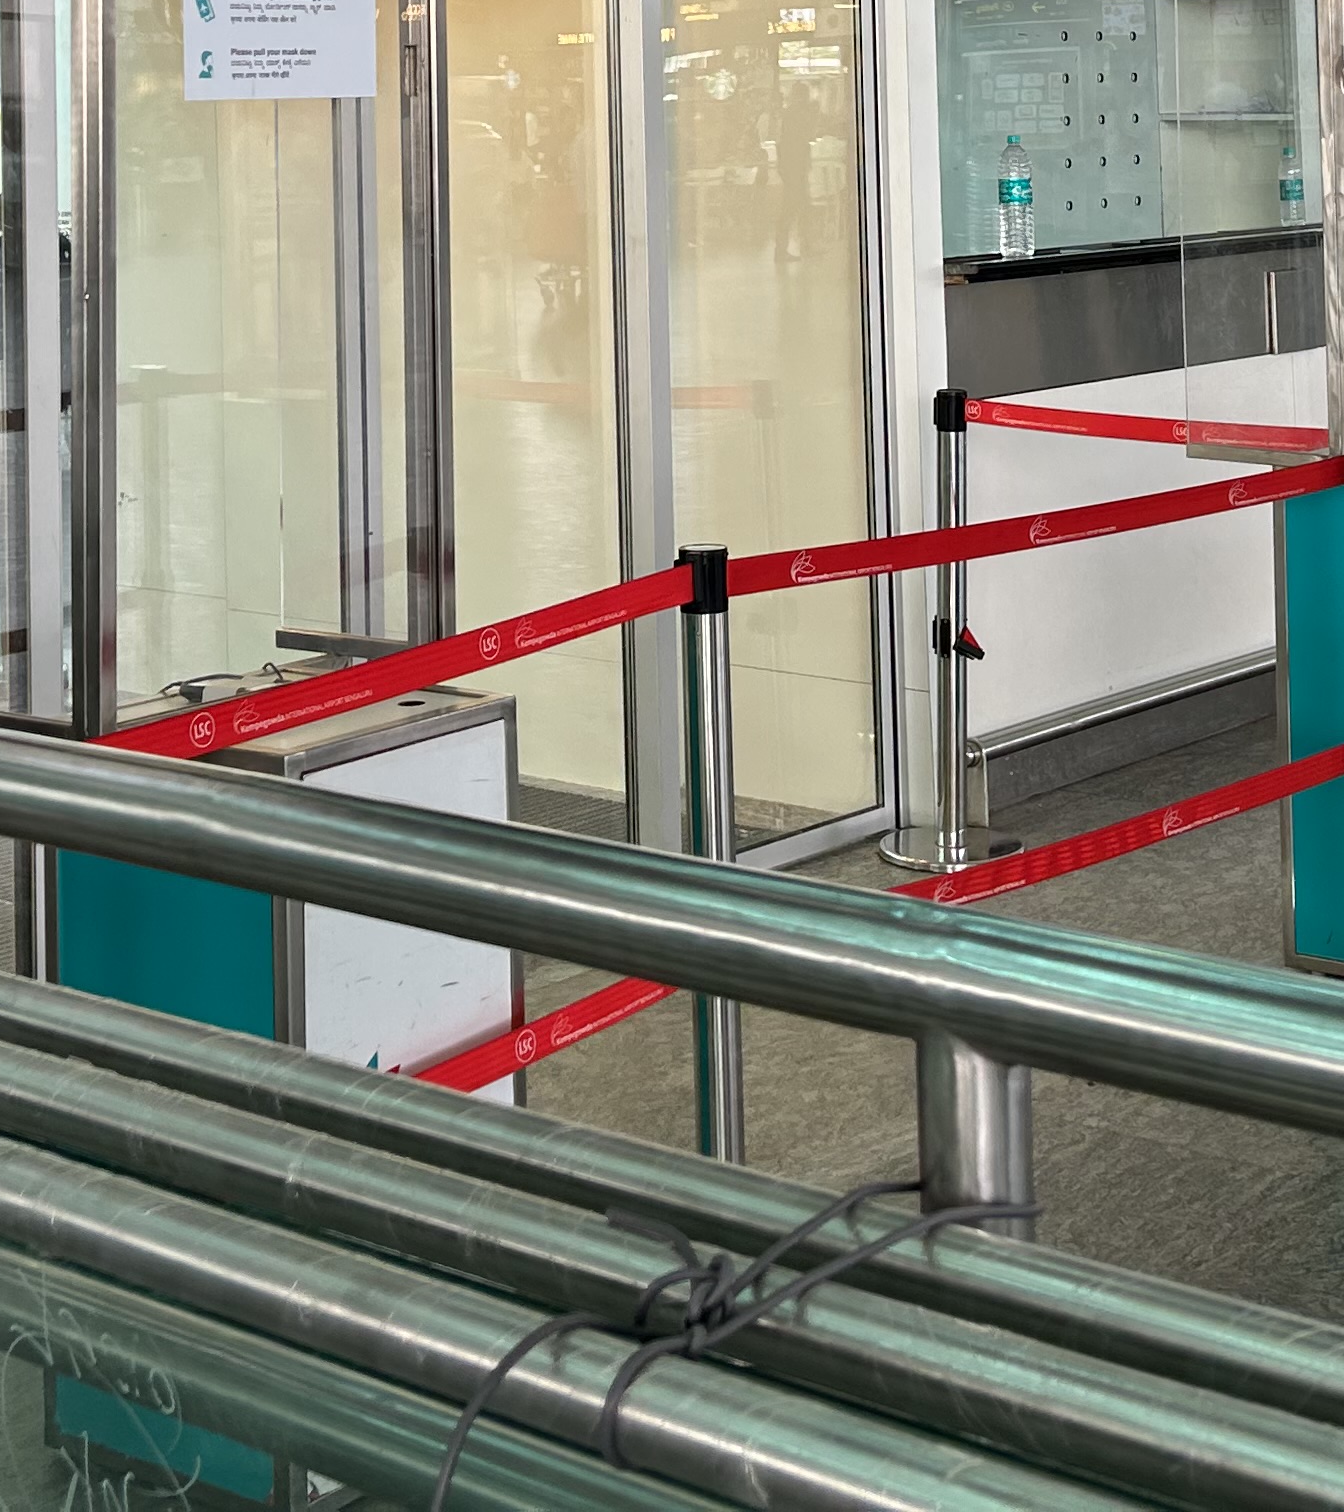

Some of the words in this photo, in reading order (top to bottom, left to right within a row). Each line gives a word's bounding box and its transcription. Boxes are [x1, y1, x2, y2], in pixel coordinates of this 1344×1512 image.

[482, 635, 498, 653] LSC
[193, 719, 212, 741] LSC
[518, 1036, 534, 1056] LSC
